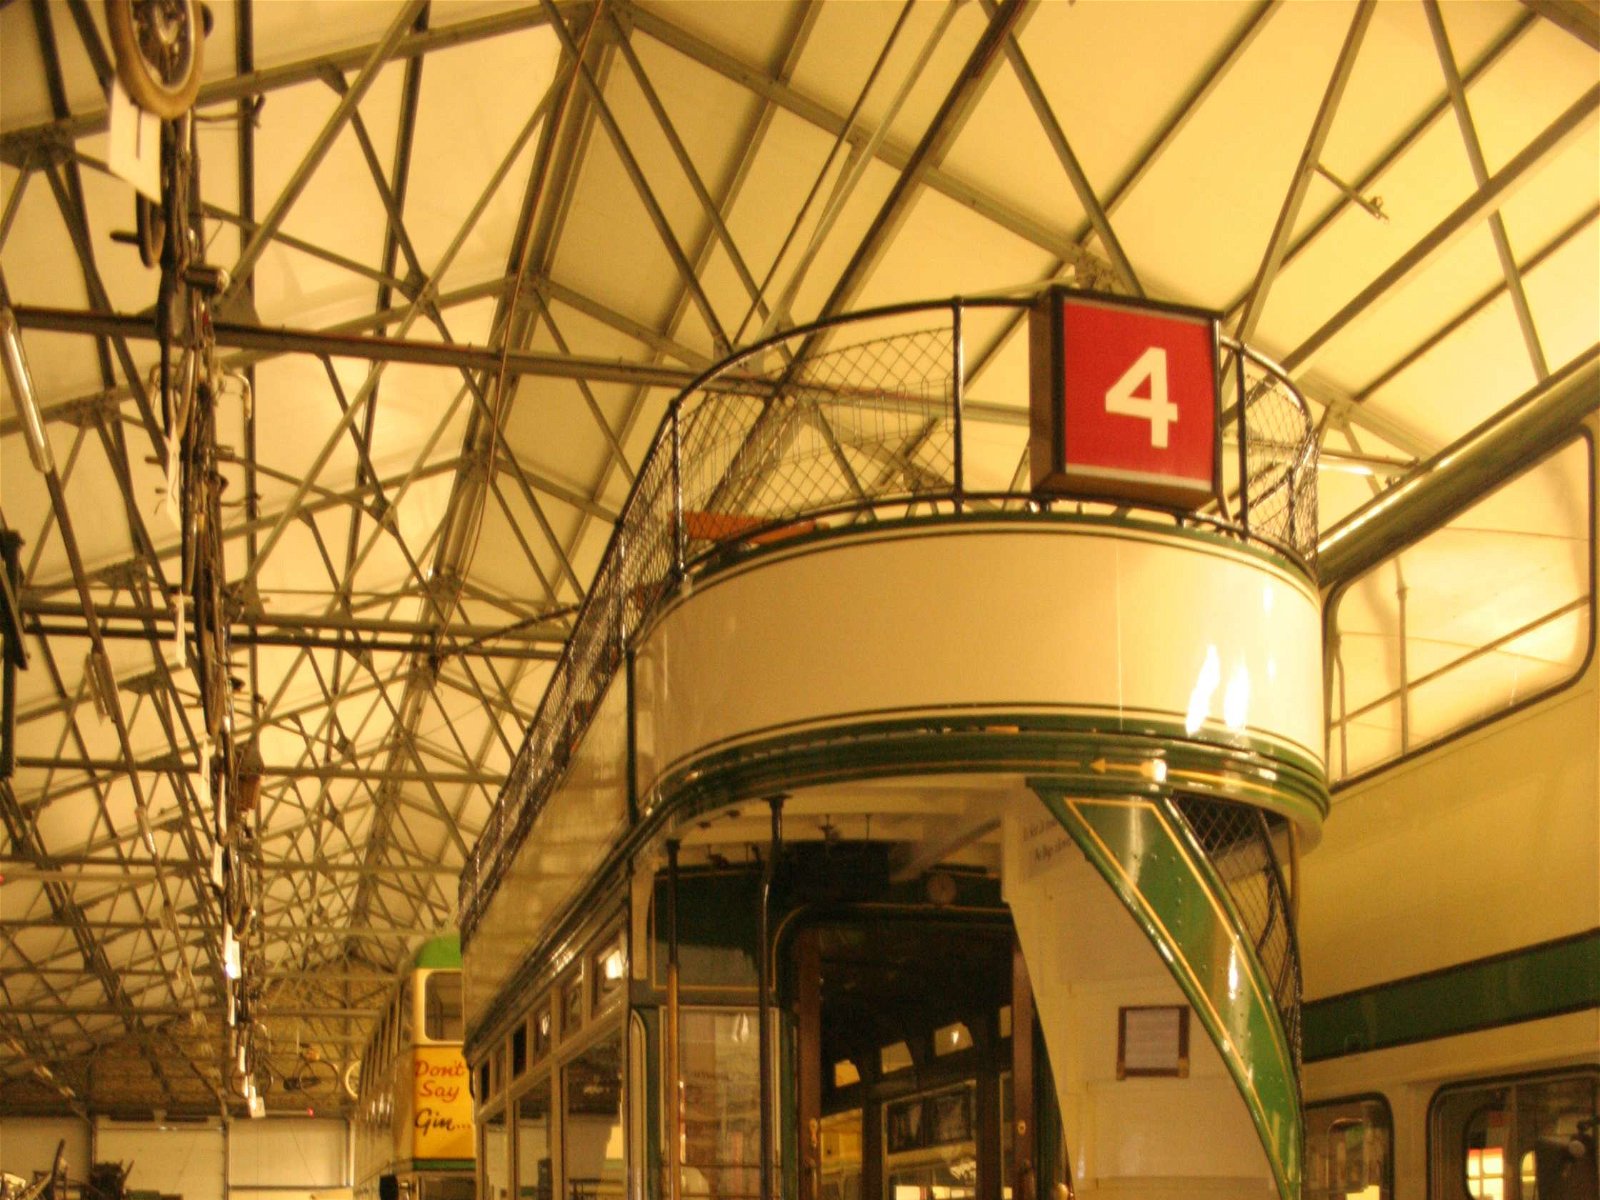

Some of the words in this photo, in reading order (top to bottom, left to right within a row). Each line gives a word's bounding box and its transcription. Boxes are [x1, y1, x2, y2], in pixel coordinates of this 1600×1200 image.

[1105, 346, 1178, 449] 4
[415, 1060, 465, 1078] Don't
[419, 1080, 460, 1103] Say
